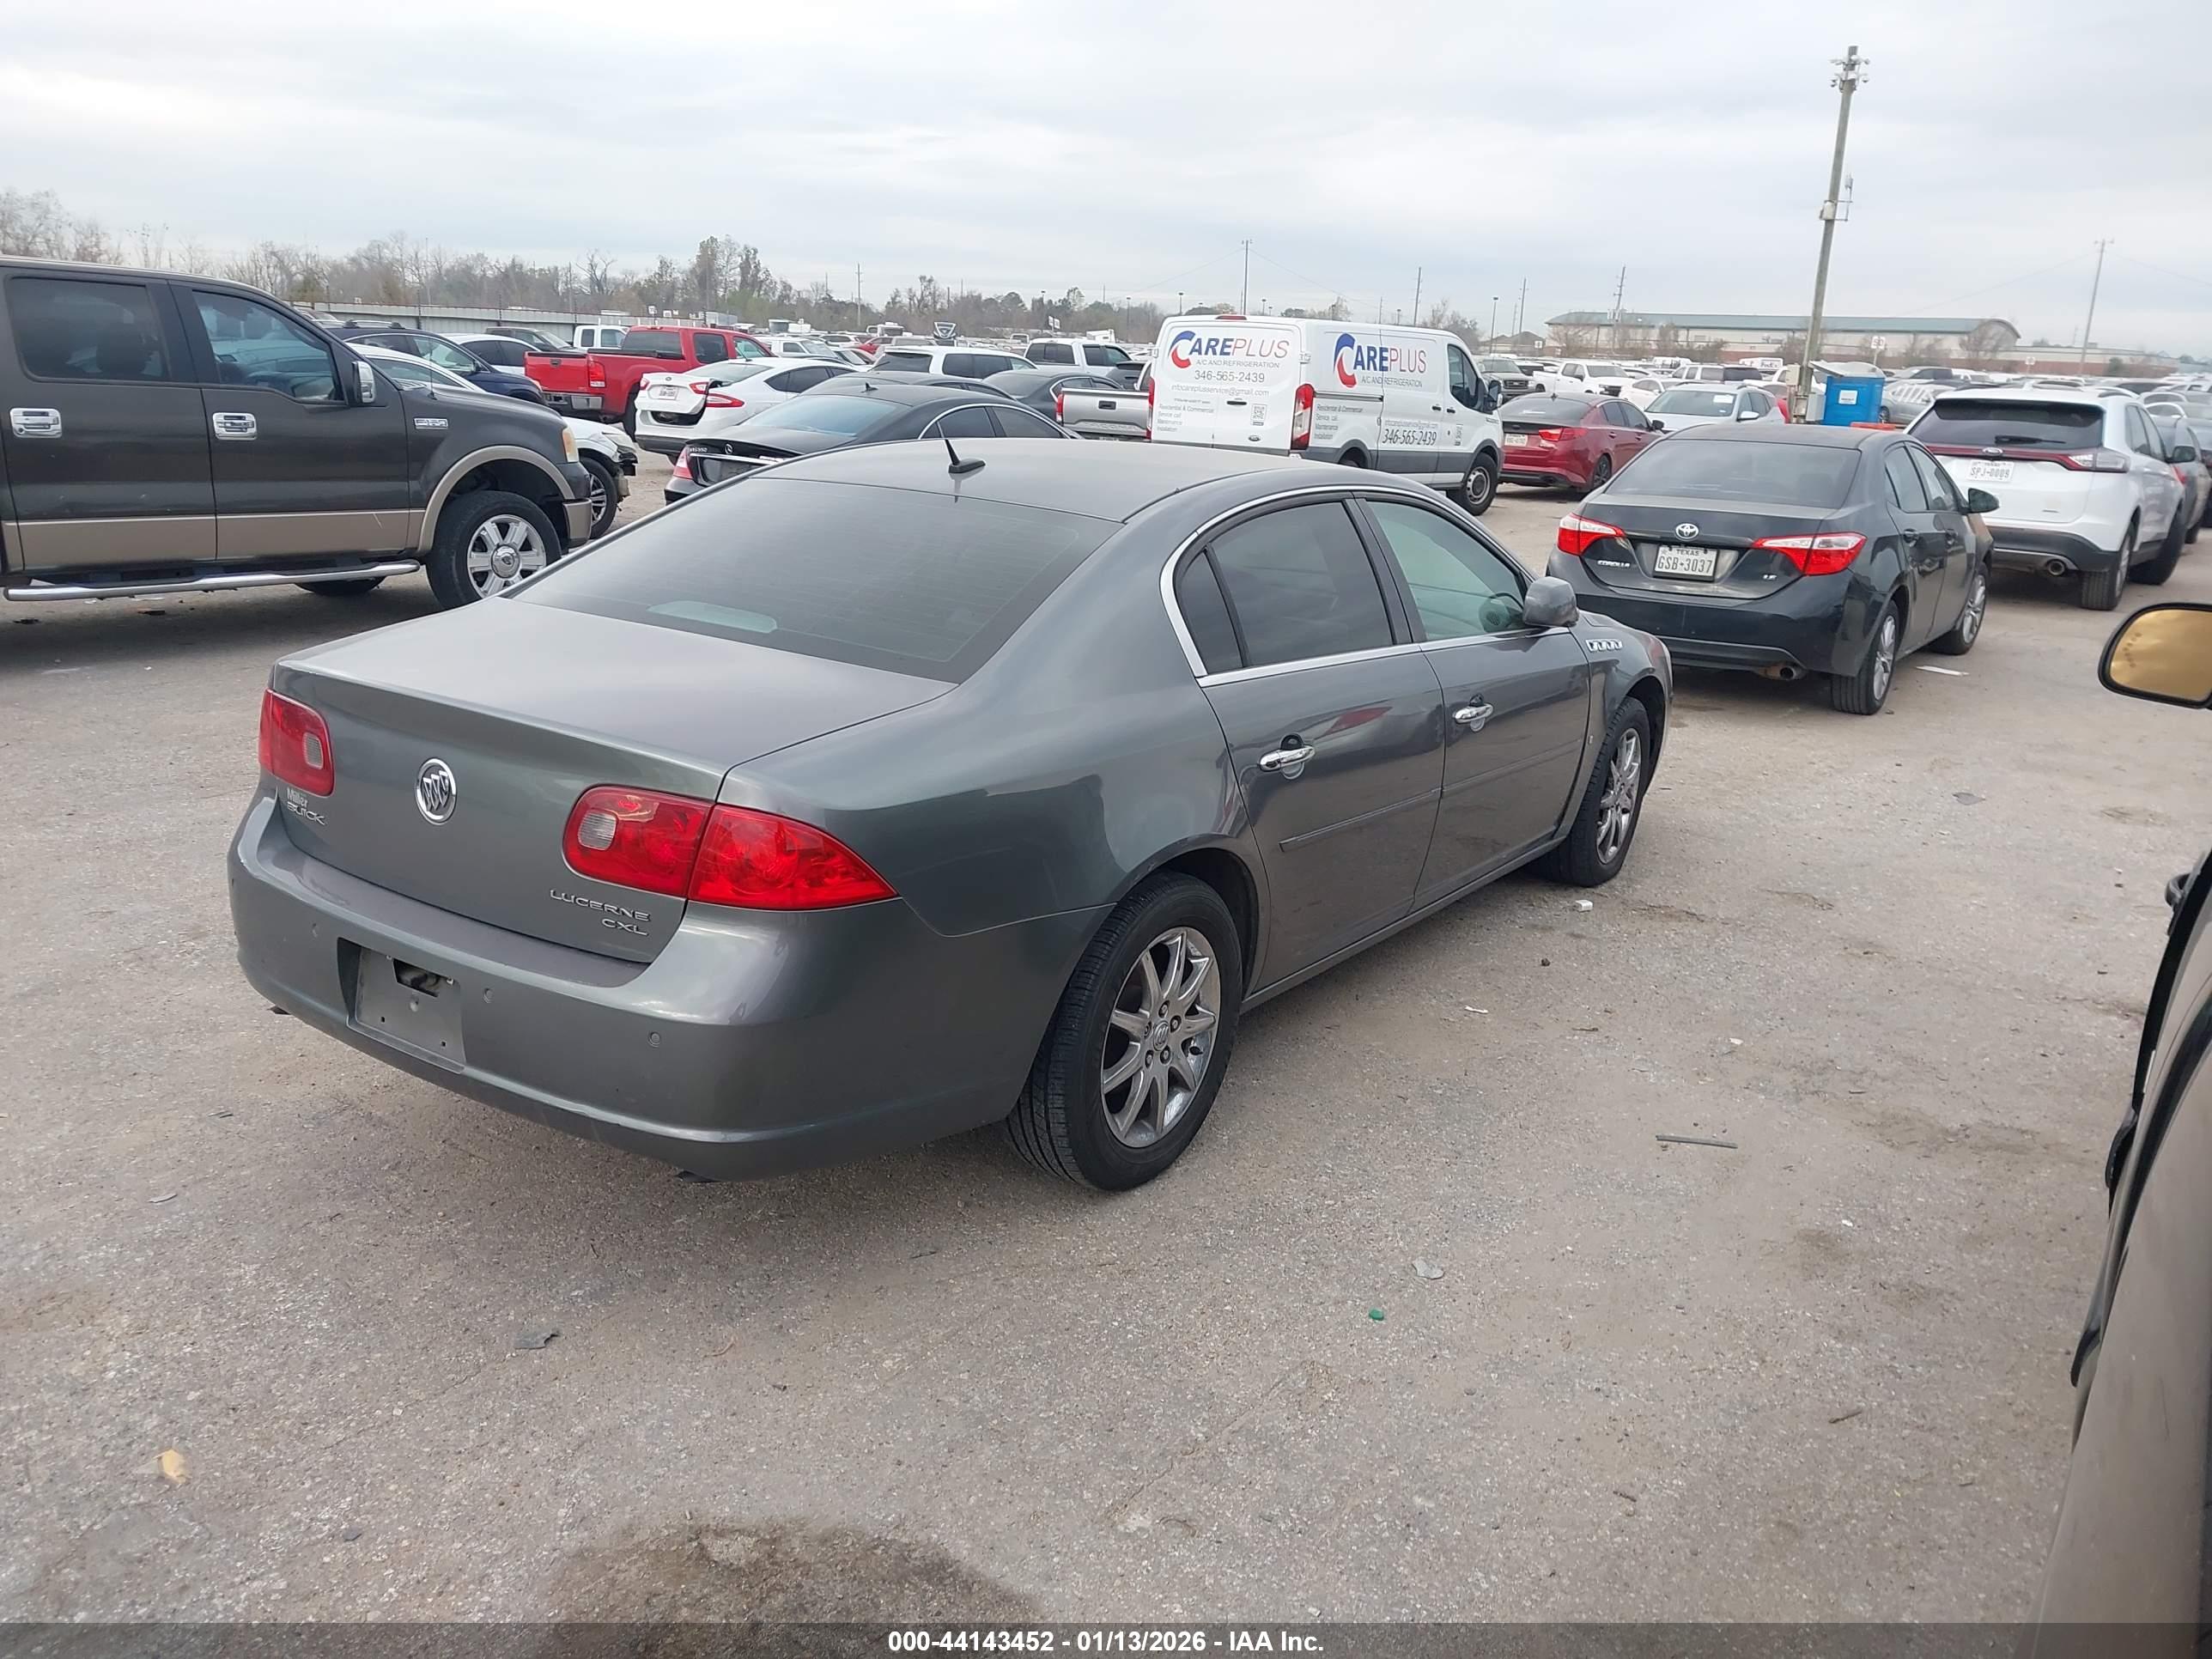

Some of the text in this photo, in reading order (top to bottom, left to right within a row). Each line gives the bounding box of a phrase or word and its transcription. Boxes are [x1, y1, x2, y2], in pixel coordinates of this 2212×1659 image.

[1224, 361, 1280, 369] REFRIGERATION
[1194, 370, 1266, 383] 346-565-2439
[1382, 378, 1423, 387] REFRIGERATION
[1382, 428, 1437, 447] 346-565-2439
[287, 800, 325, 825] BUICK
[550, 889, 651, 921] LUCERNE
[601, 918, 649, 936] CXL
